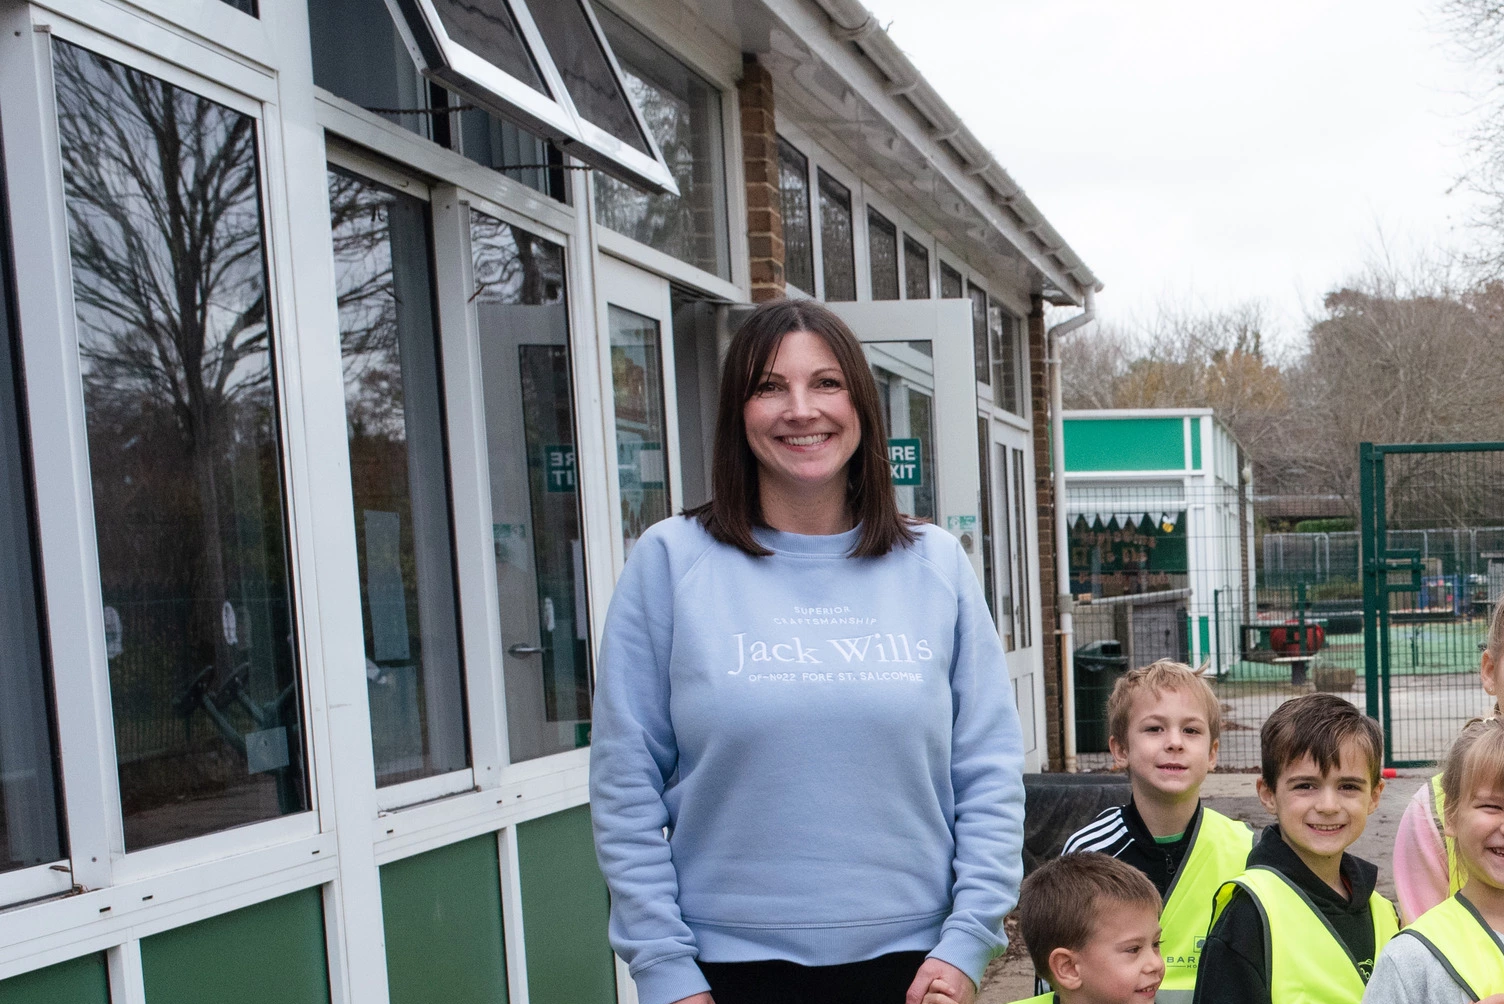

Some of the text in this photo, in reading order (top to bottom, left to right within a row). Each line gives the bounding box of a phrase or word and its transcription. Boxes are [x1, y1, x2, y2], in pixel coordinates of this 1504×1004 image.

[889, 446, 916, 461] RE
[890, 464, 916, 479] XIT
[793, 605, 850, 615] SUPERIOR
[773, 617, 878, 626] CRAFTSMANSHIP
[727, 632, 933, 675] Jack Wills
[802, 672, 834, 682] FORE
[860, 671, 924, 682] SALCOMBE
